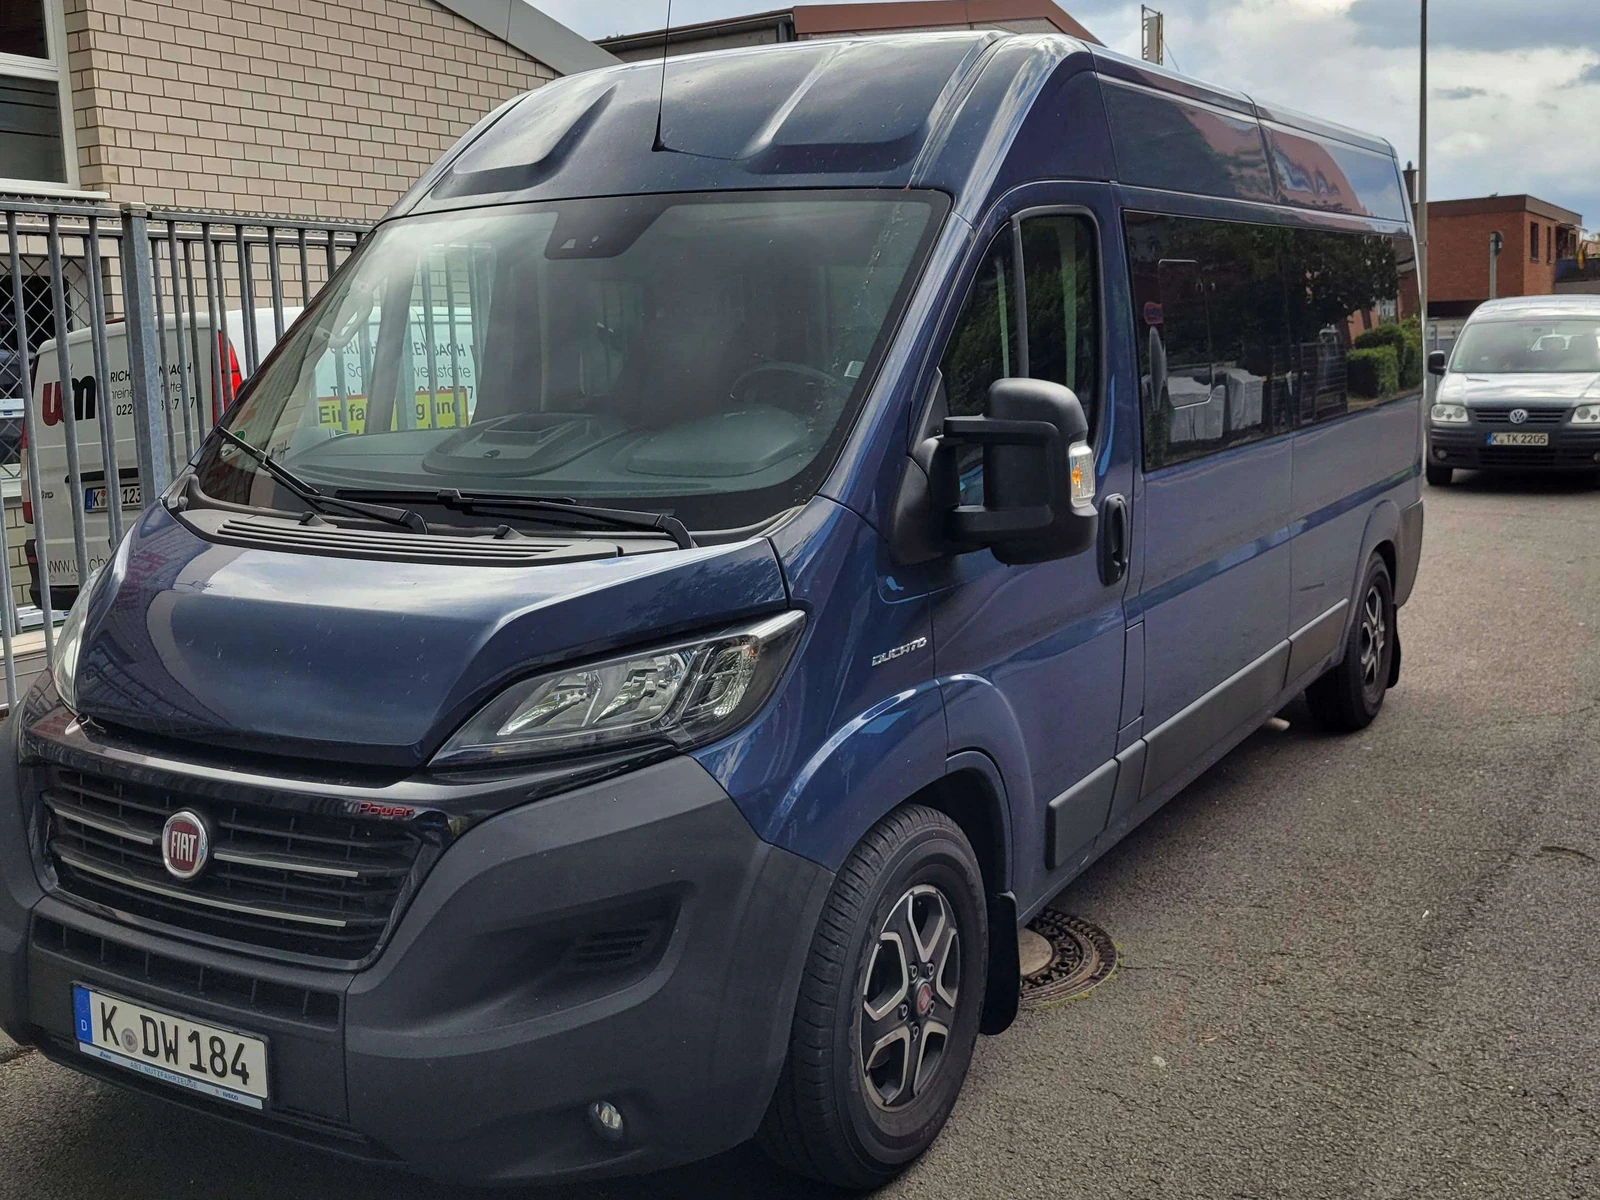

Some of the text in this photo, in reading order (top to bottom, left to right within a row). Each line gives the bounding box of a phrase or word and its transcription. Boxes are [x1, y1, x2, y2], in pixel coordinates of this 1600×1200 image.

[1506, 434, 1518, 444] TK
[1520, 434, 1546, 444] 2205
[93, 491, 100, 507] K
[872, 636, 928, 667] DUCATO
[358, 801, 414, 816] Power
[170, 830, 197, 863] FIAT
[81, 1001, 250, 1086] D K DW 184
